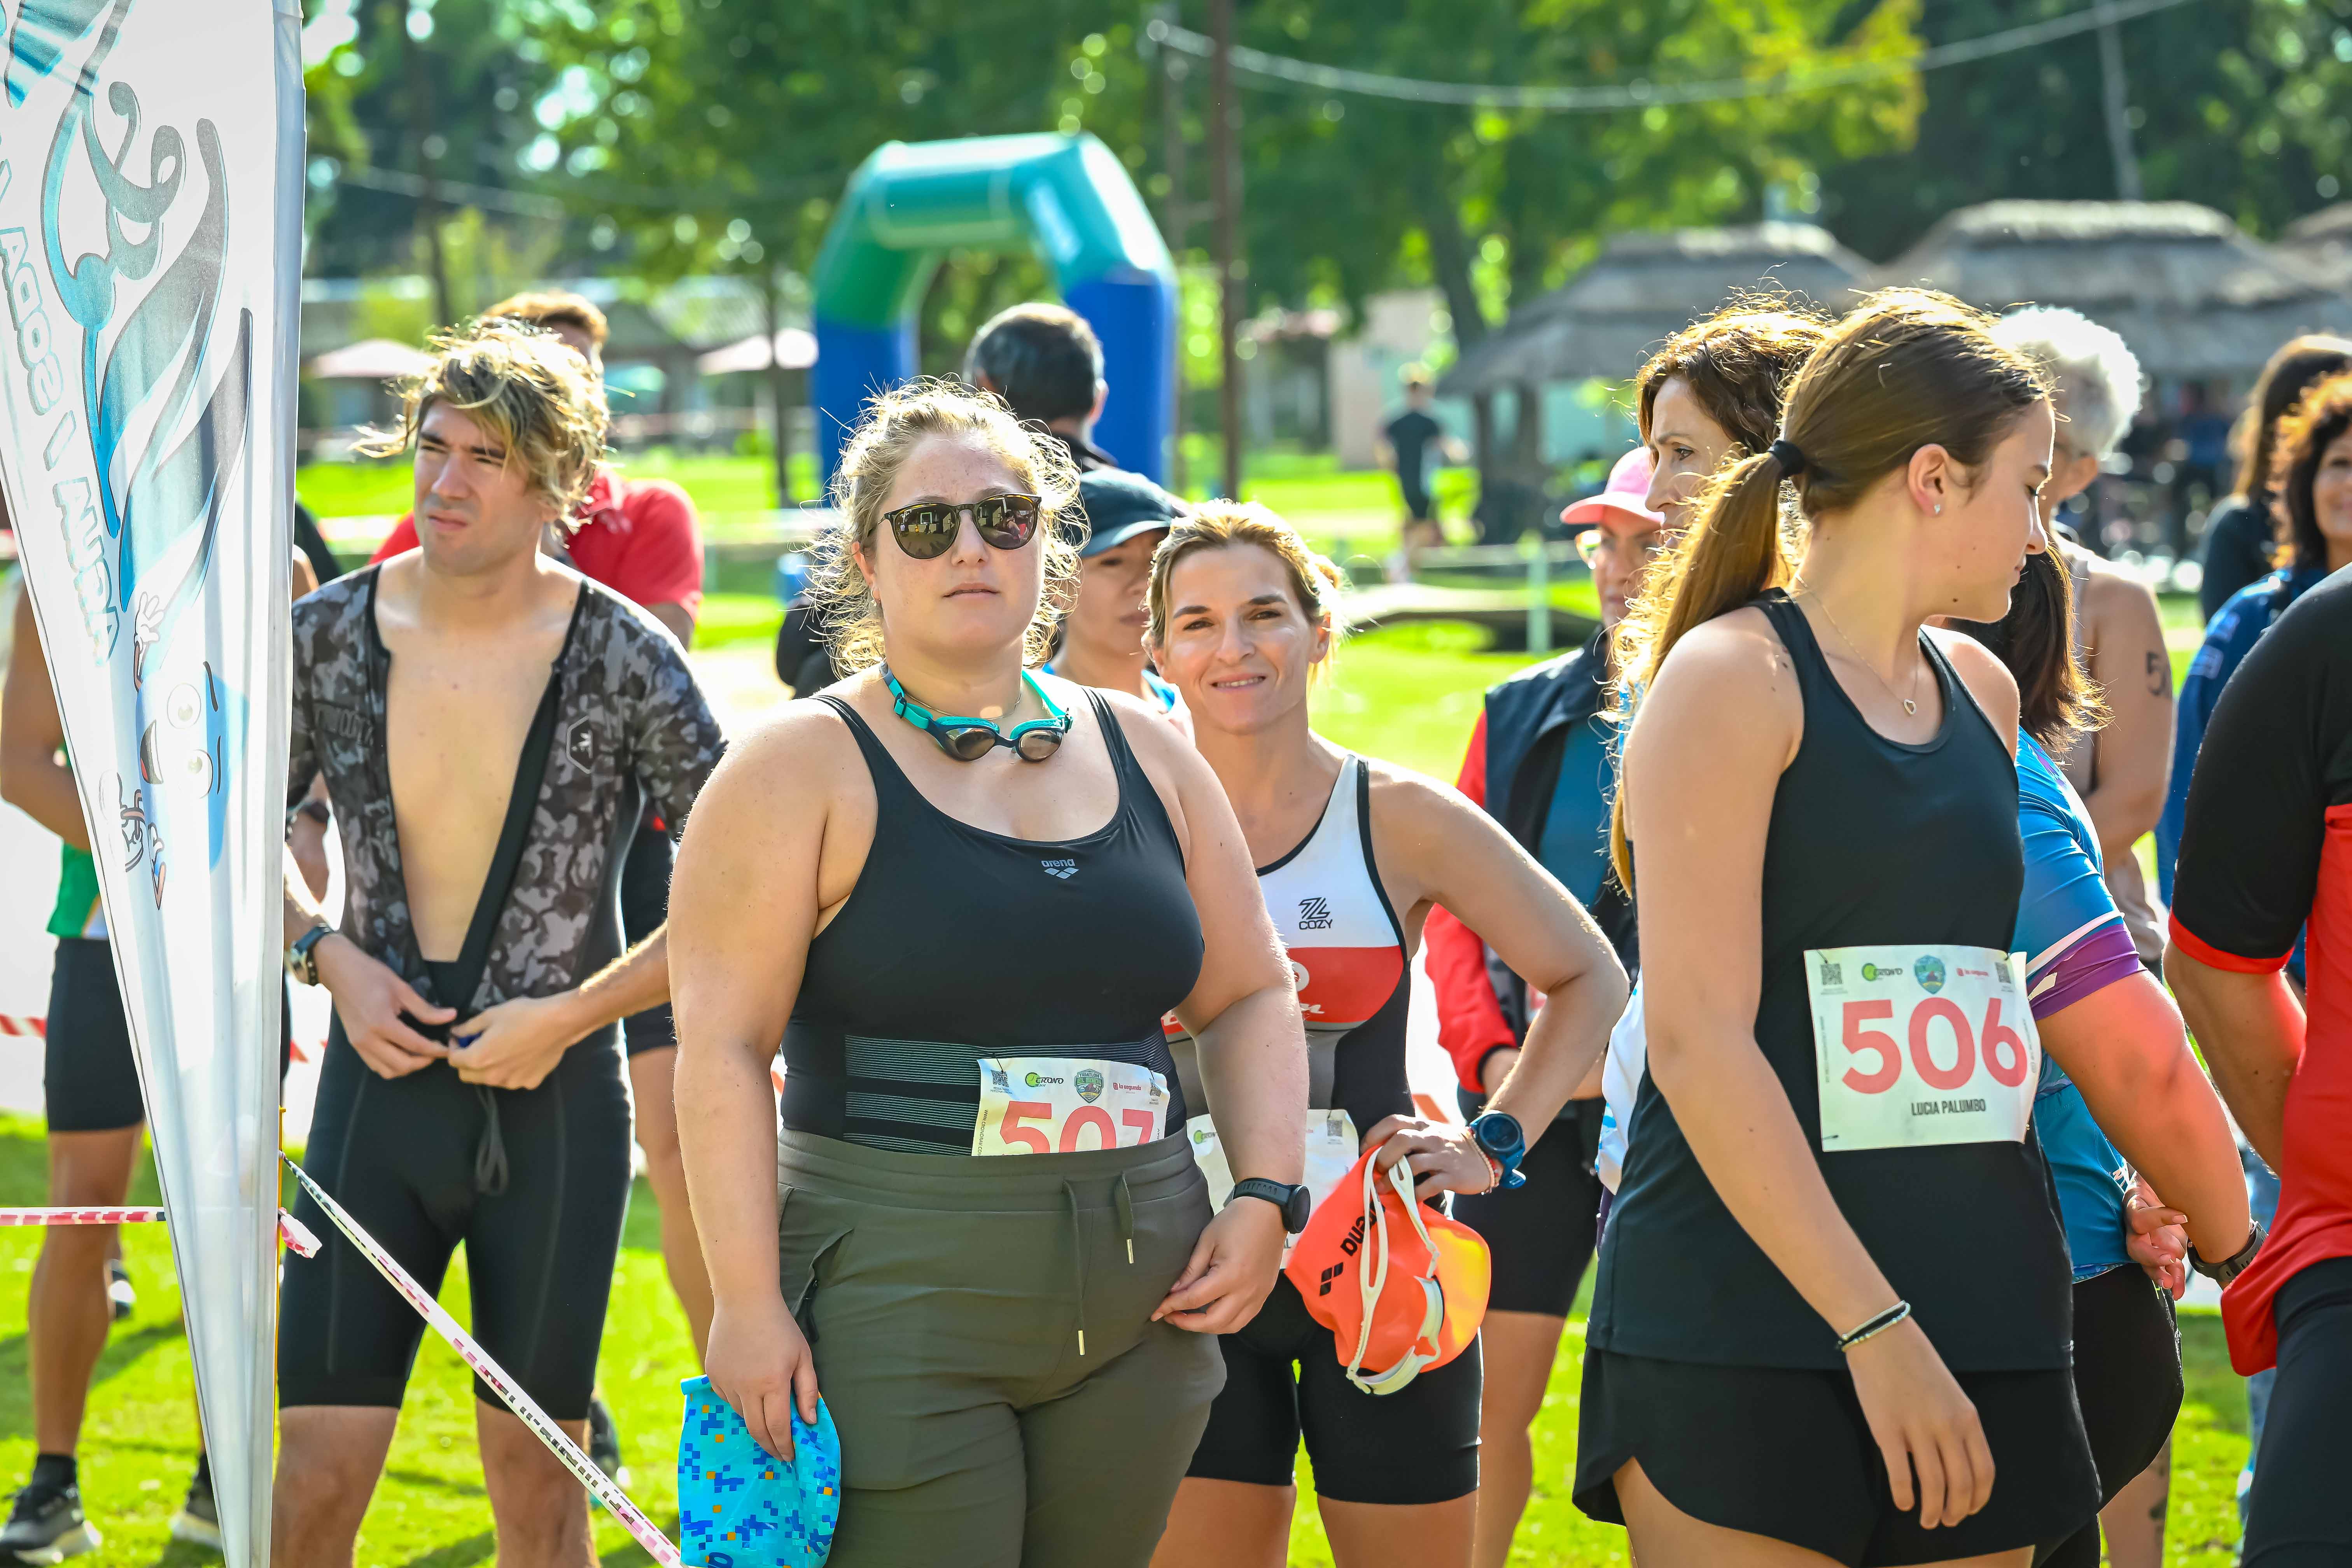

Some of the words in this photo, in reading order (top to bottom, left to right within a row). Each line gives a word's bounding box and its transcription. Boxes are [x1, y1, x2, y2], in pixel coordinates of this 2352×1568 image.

[1041, 859, 1075, 867] arena
[1298, 919, 1333, 930] COZY
[1841, 997, 2028, 1094] 506
[1911, 1101, 1940, 1115] LUCIA
[1942, 1099, 1986, 1114] PALUMBO
